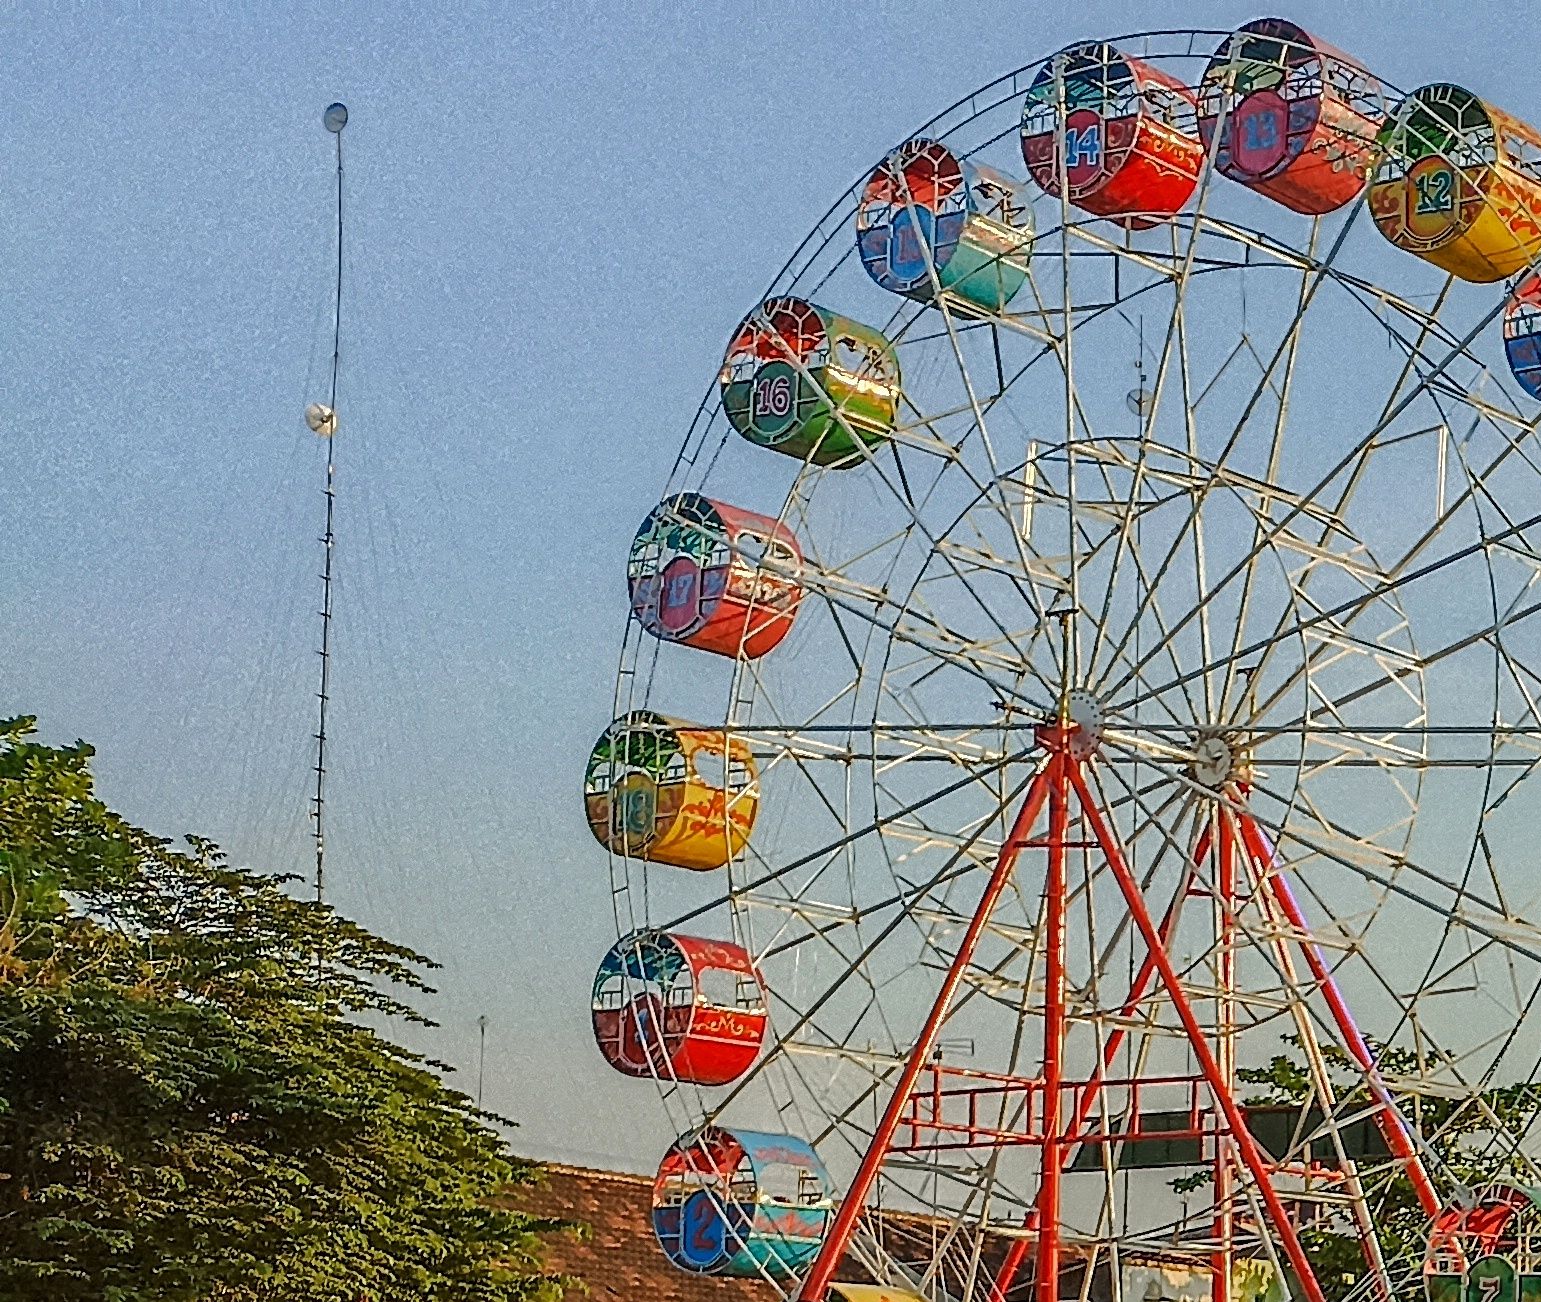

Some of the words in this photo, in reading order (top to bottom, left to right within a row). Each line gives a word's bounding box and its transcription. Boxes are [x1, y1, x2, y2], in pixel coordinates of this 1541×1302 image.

[1064, 124, 1098, 167] 14
[1415, 169, 1452, 214] 12
[756, 375, 790, 416] 16
[667, 573, 694, 608] 17
[693, 1199, 717, 1250] 2
